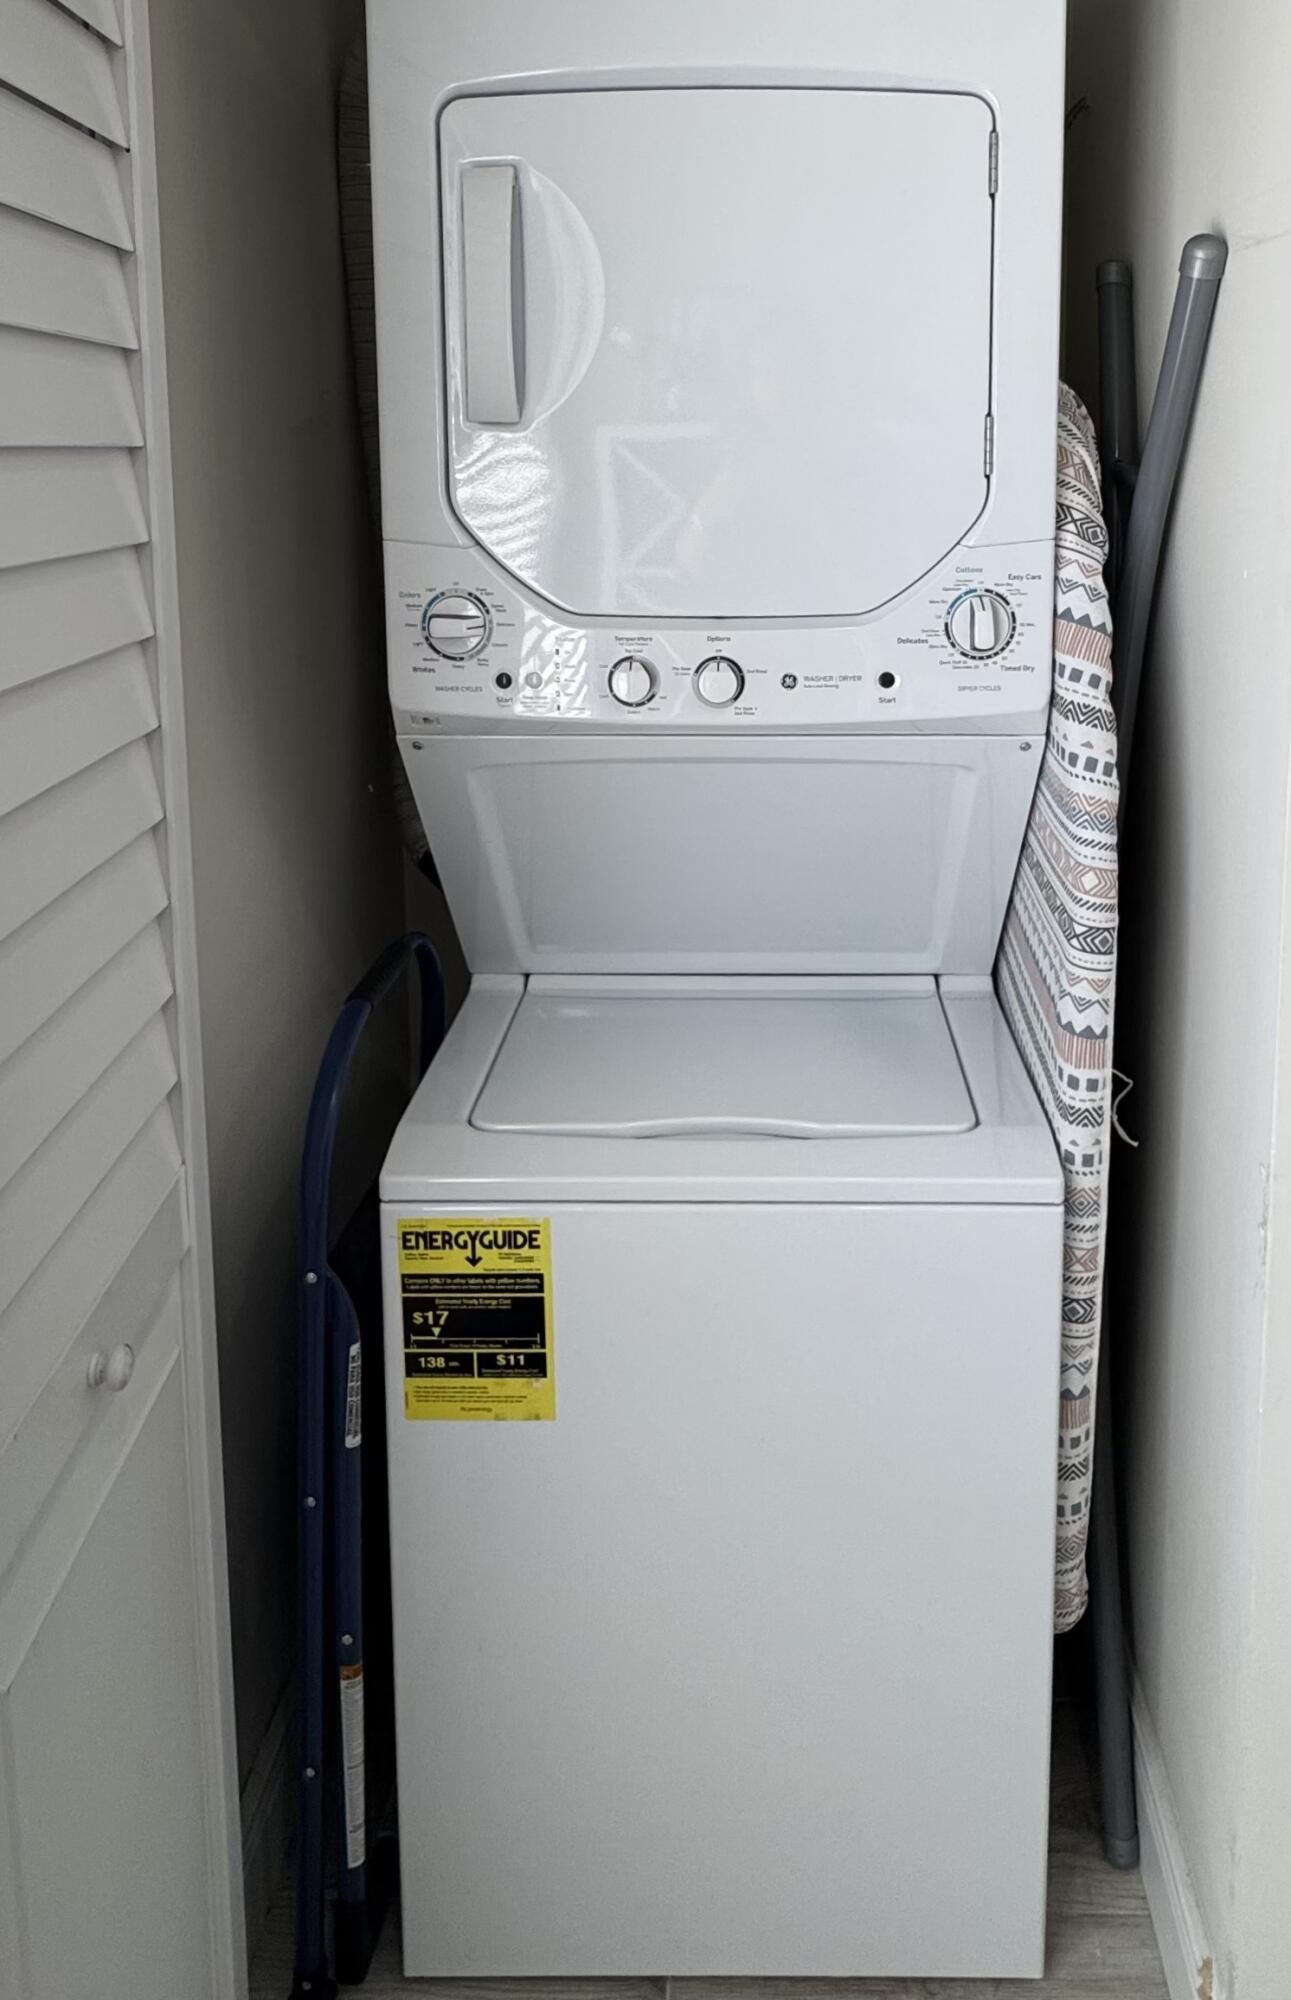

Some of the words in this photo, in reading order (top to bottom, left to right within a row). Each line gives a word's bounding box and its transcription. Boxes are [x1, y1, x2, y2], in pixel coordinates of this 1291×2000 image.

[955, 566, 983, 574] Cottons
[1008, 573, 1024, 581] Easy
[896, 637, 929, 645] Delicates
[1000, 664, 1022, 672] Timed
[1022, 665, 1036, 673] Dry
[402, 1229, 541, 1250] ENERGYGUIDE
[412, 1311, 449, 1325] $17
[418, 1356, 446, 1368] 138
[496, 1354, 526, 1366] $11
